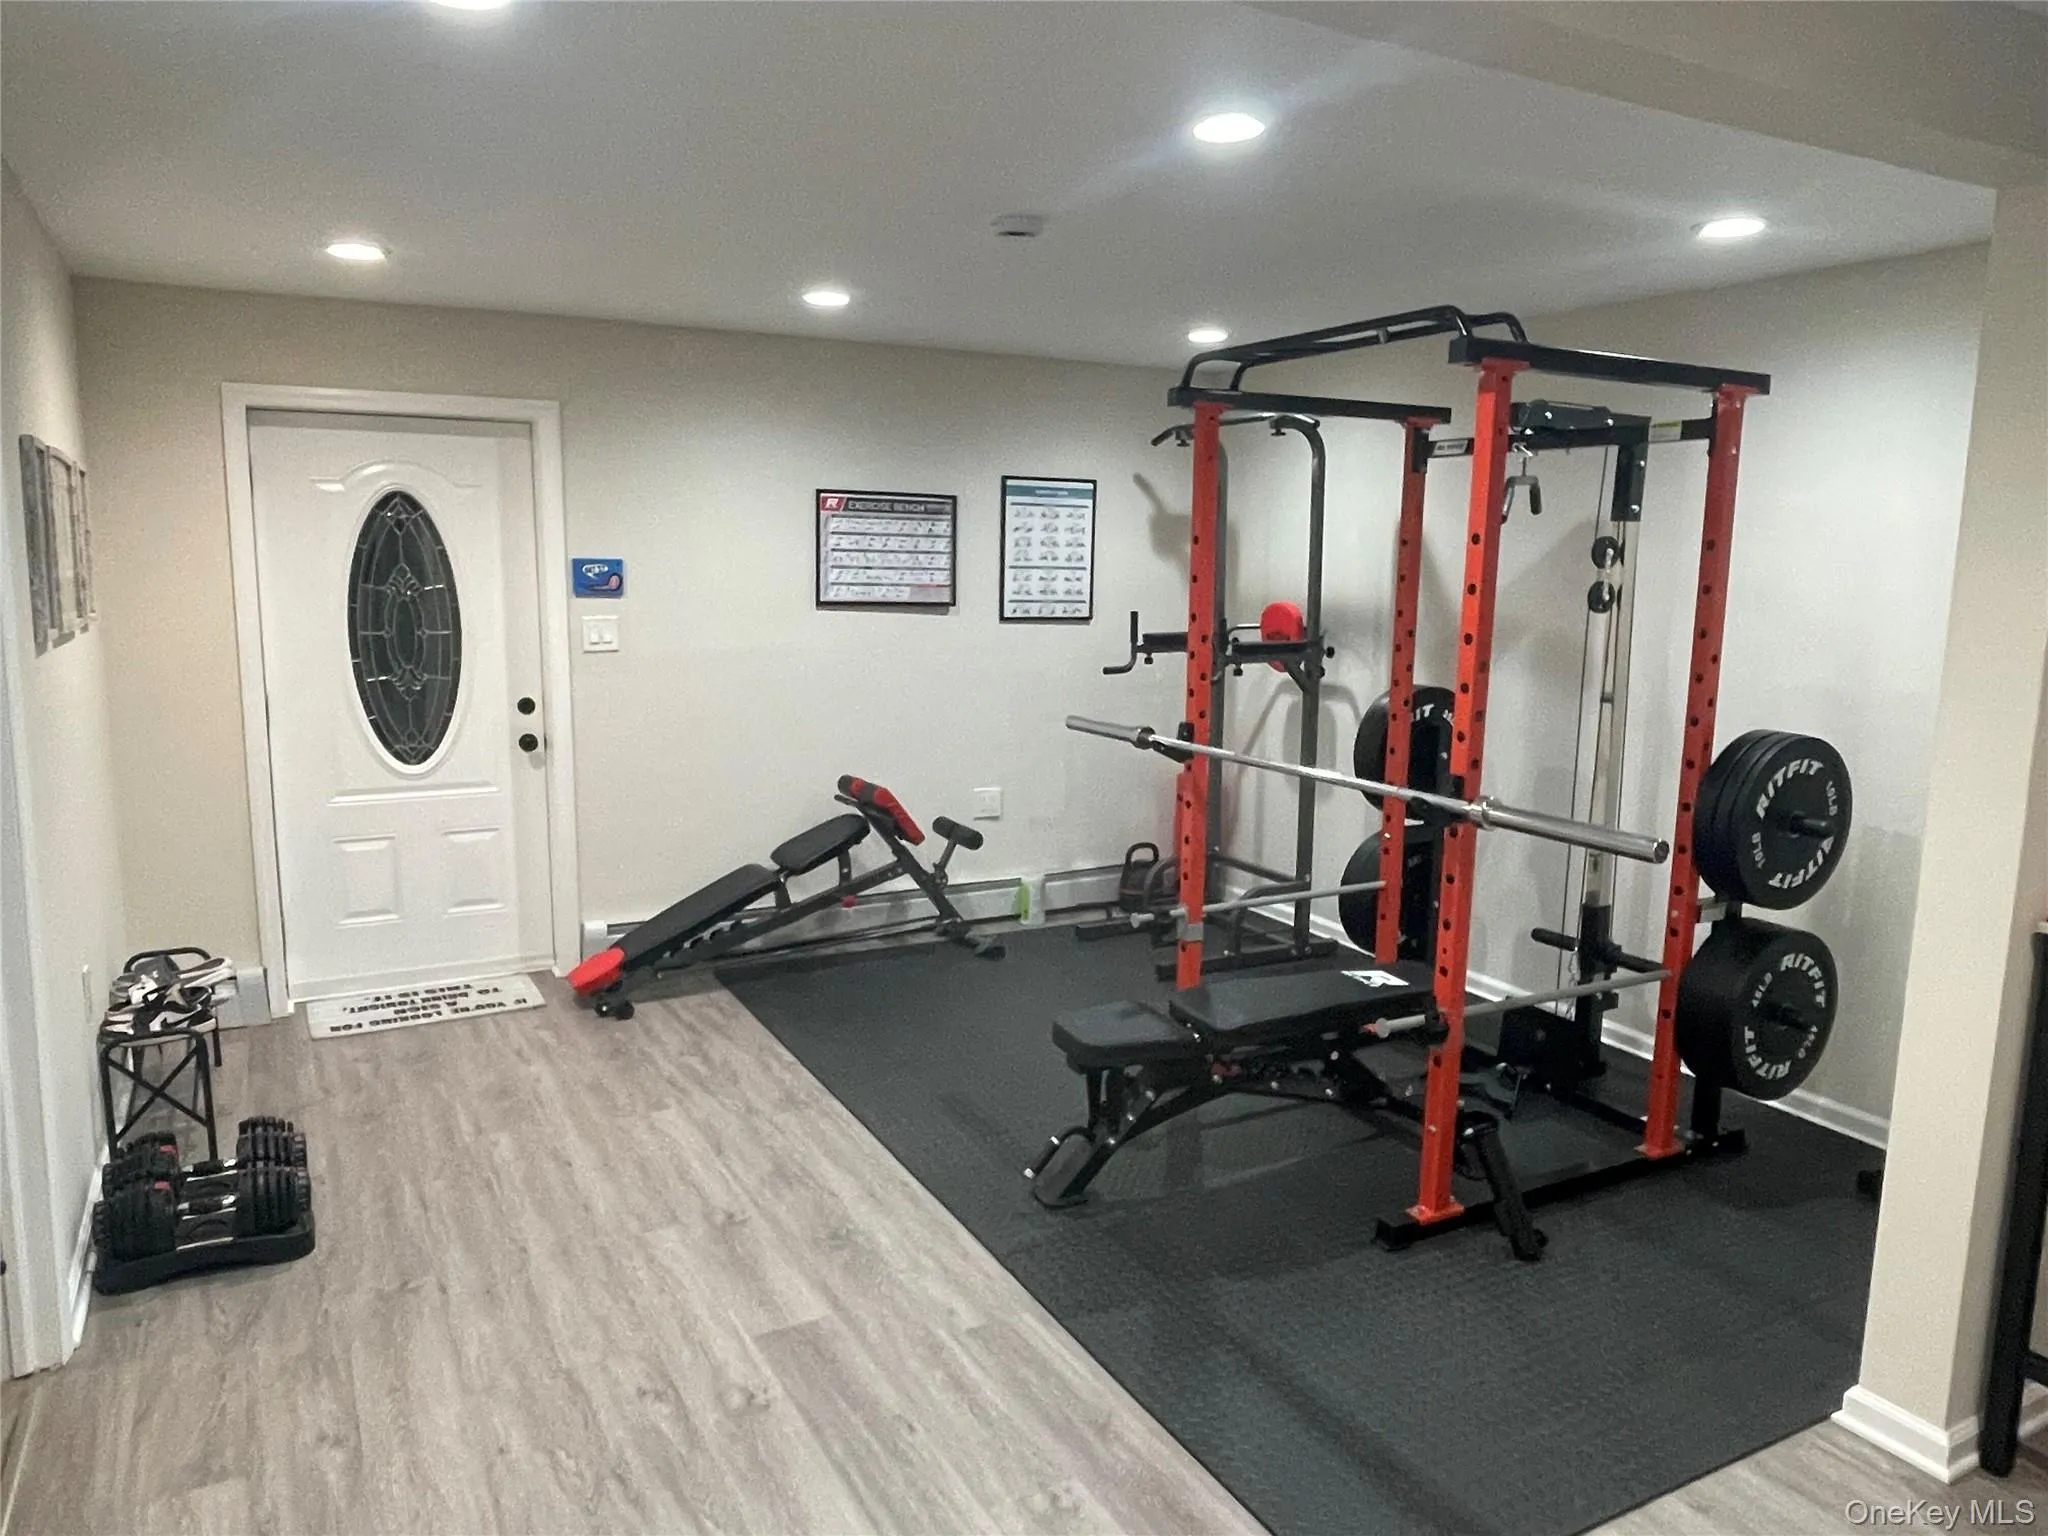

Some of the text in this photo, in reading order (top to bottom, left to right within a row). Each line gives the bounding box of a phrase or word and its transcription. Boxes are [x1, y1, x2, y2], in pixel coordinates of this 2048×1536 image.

[1756, 758, 1825, 819] RITFIT
[1768, 836, 1834, 889] RITFIT
[1780, 953, 1826, 1008] RITFIT
